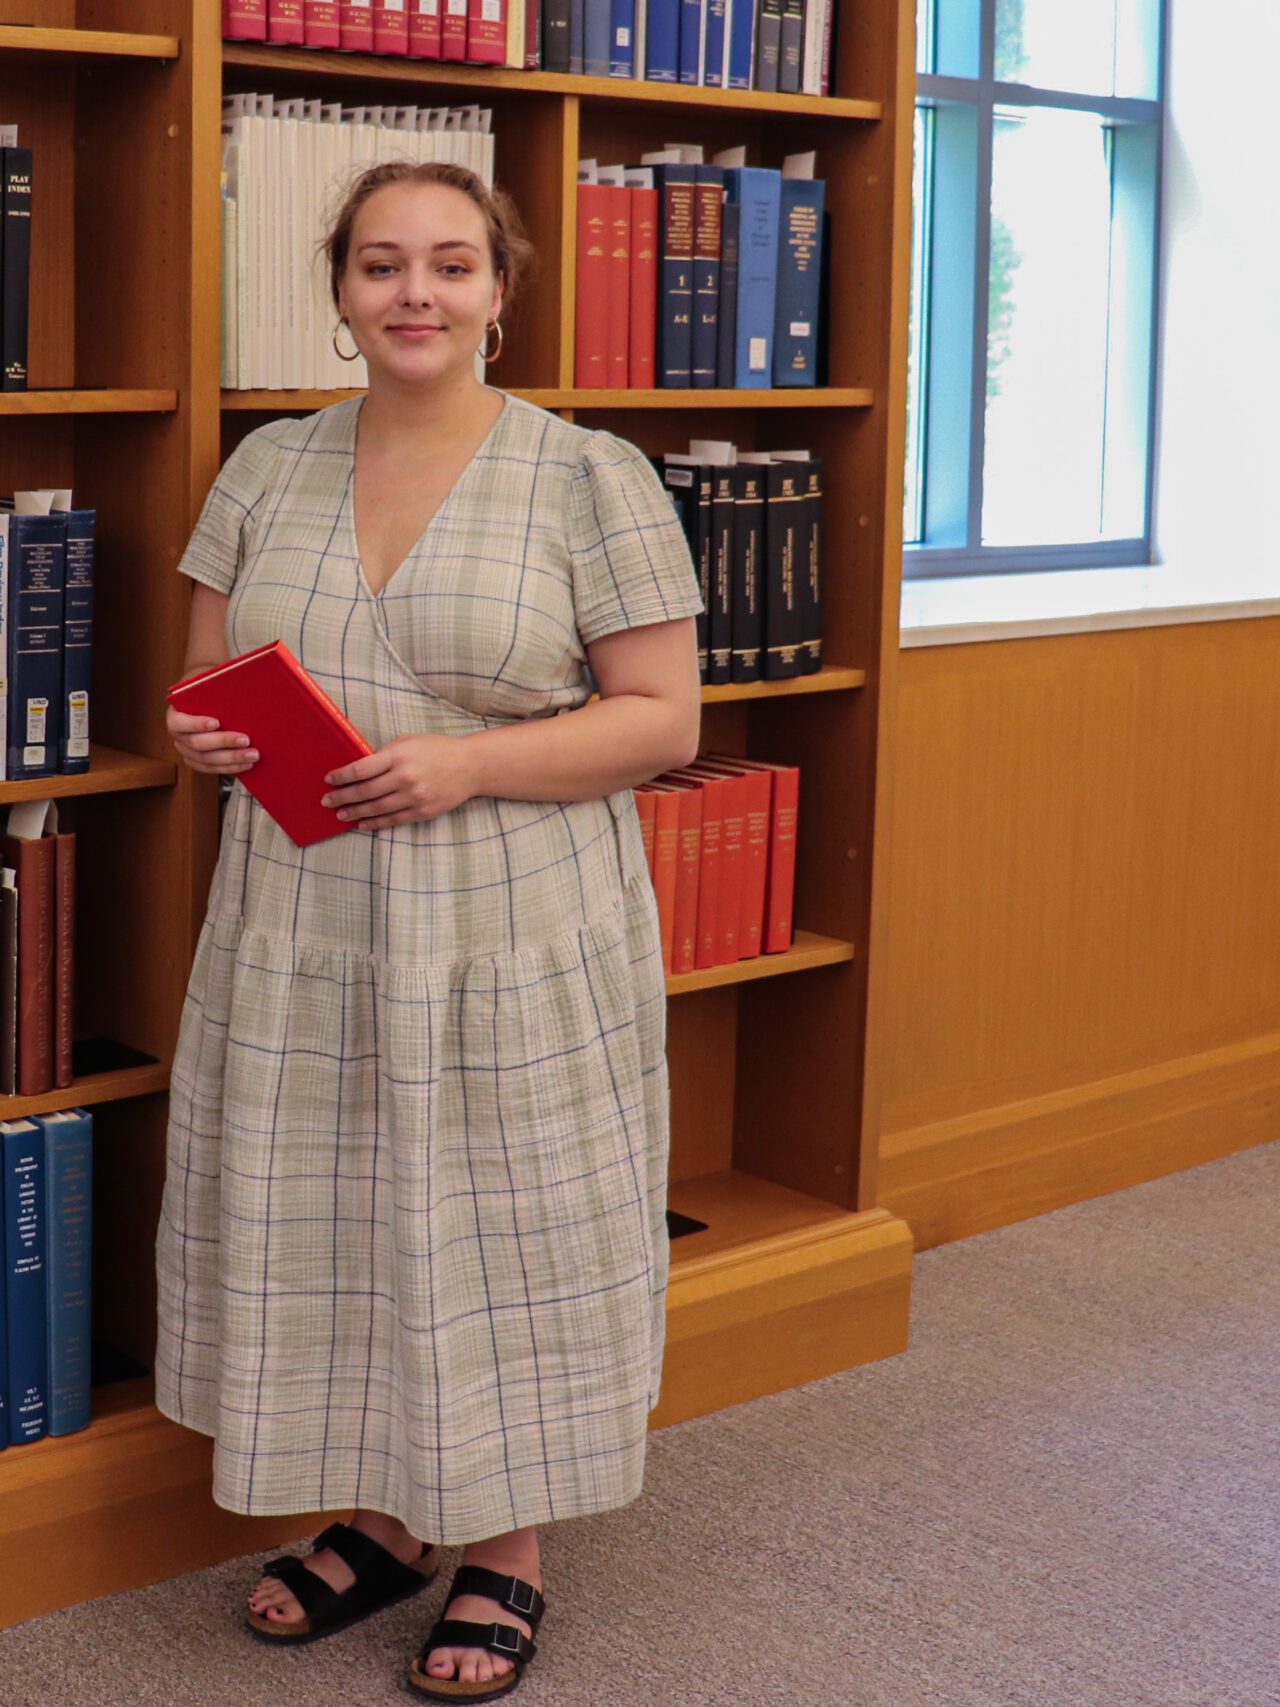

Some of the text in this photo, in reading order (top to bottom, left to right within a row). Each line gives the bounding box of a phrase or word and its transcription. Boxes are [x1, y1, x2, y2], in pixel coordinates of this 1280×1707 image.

[10, 175, 30, 183] PLAY
[8, 185, 31, 193] INDEX
[679, 275, 687, 287] 1
[706, 275, 715, 287] 2
